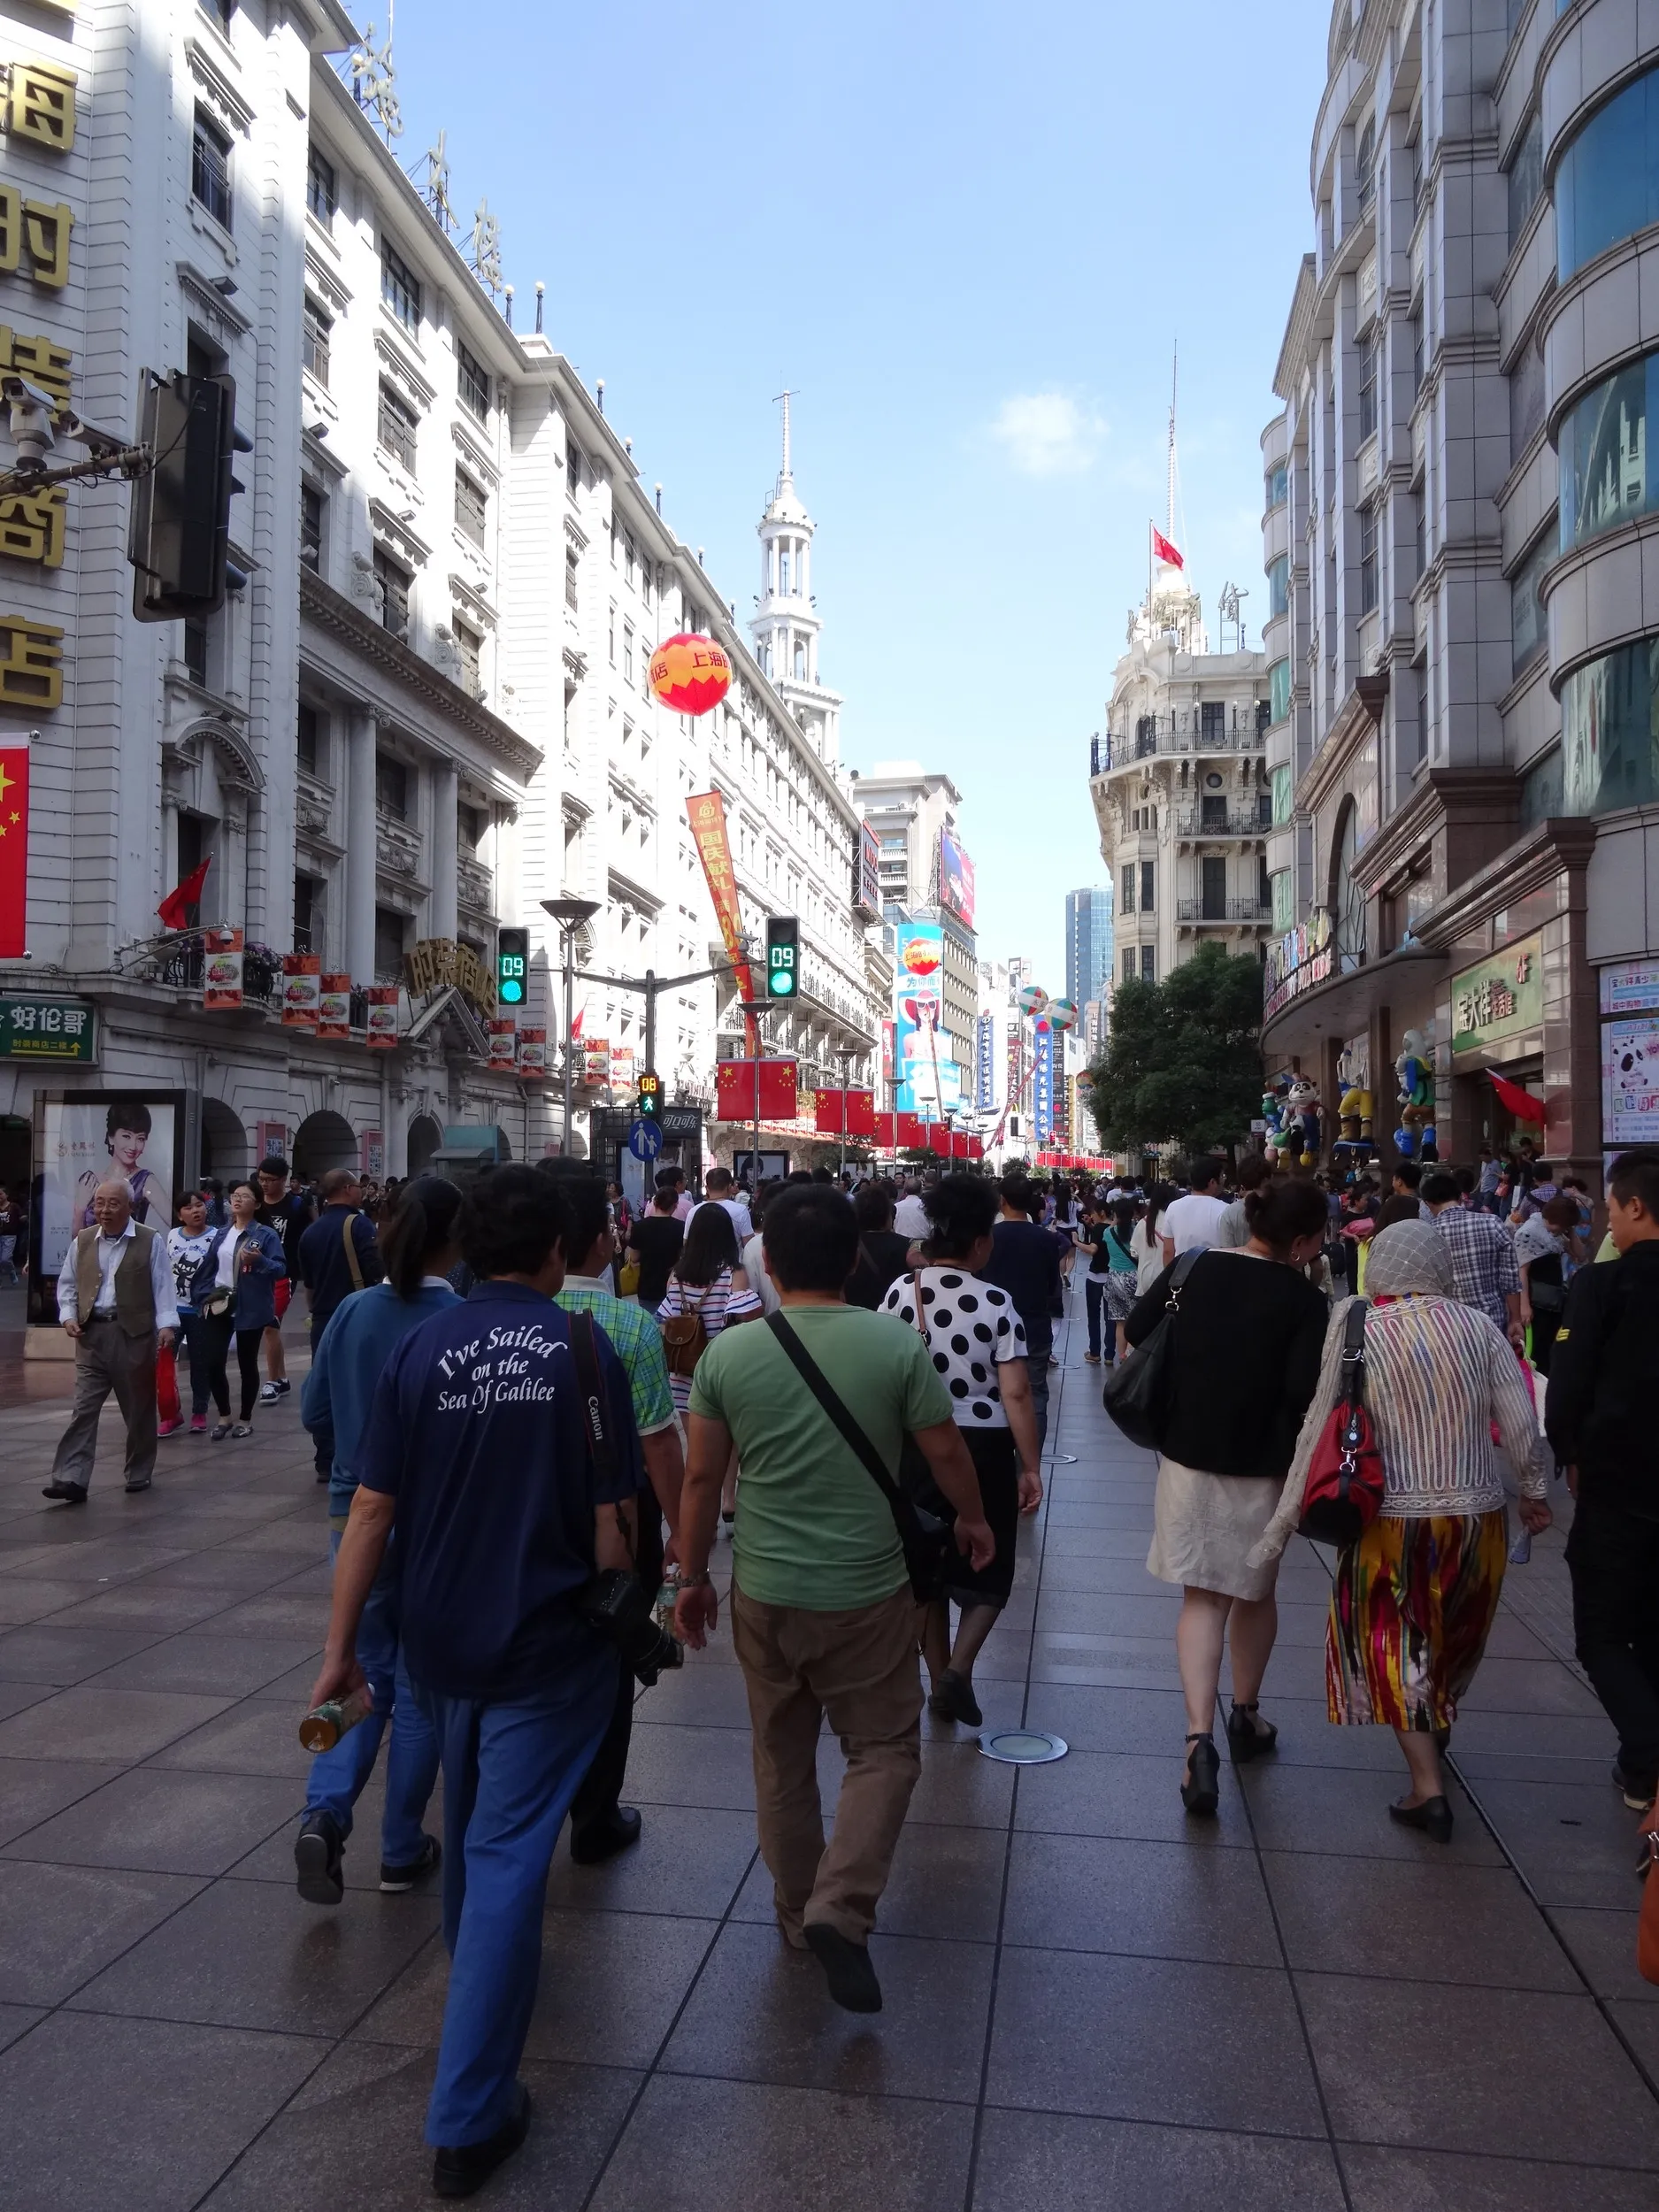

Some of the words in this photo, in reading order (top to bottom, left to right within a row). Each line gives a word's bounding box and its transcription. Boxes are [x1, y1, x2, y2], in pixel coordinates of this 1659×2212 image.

[503, 957, 524, 976] 09
[772, 948, 794, 967] 09
[1457, 979, 1491, 1031] 宝大祥
[11, 1006, 87, 1035] 好伦哥
[641, 1078, 657, 1092] 08
[663, 1114, 698, 1129] 可口可乐
[437, 1339, 480, 1380] I've
[487, 1325, 568, 1359] Sailed
[472, 1362, 491, 1381] on
[497, 1352, 530, 1376] the
[437, 1391, 468, 1411] Sea
[472, 1379, 494, 1414] Of
[495, 1377, 556, 1402] Galilee
[588, 1395, 603, 1441] Canon
